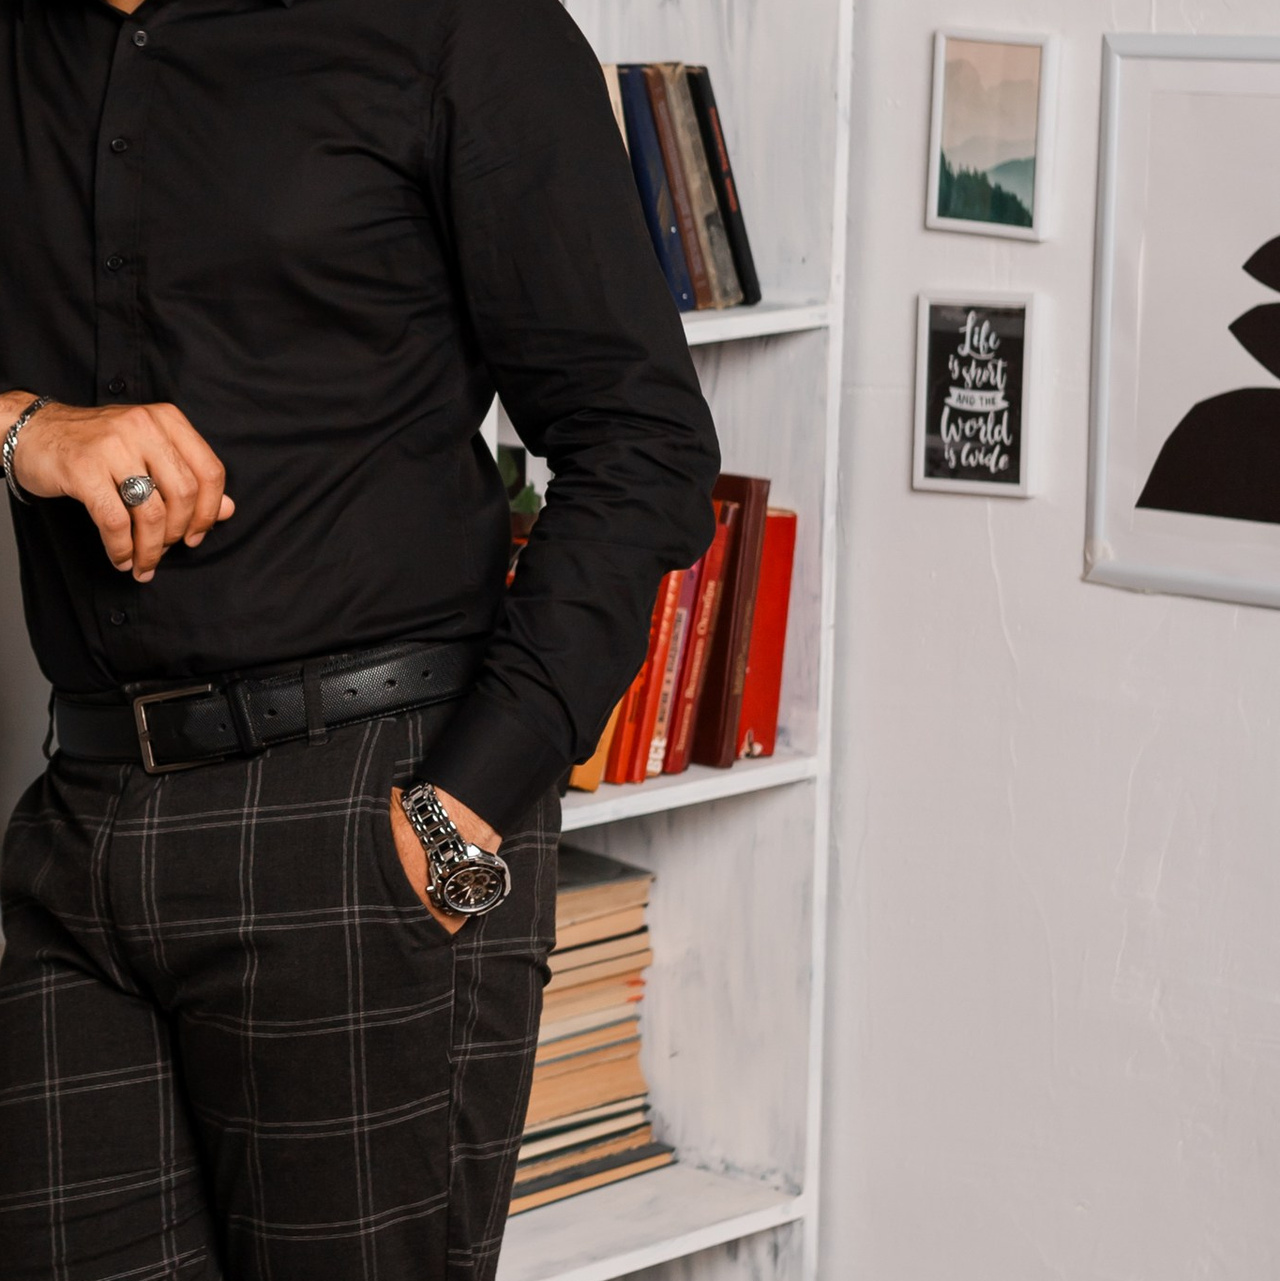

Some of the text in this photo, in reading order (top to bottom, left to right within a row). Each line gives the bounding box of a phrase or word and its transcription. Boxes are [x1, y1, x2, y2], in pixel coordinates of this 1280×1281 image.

[957, 310, 1001, 360] Life
[948, 354, 1008, 390] is short
[955, 394, 997, 407] AND THE
[944, 442, 957, 469] is
